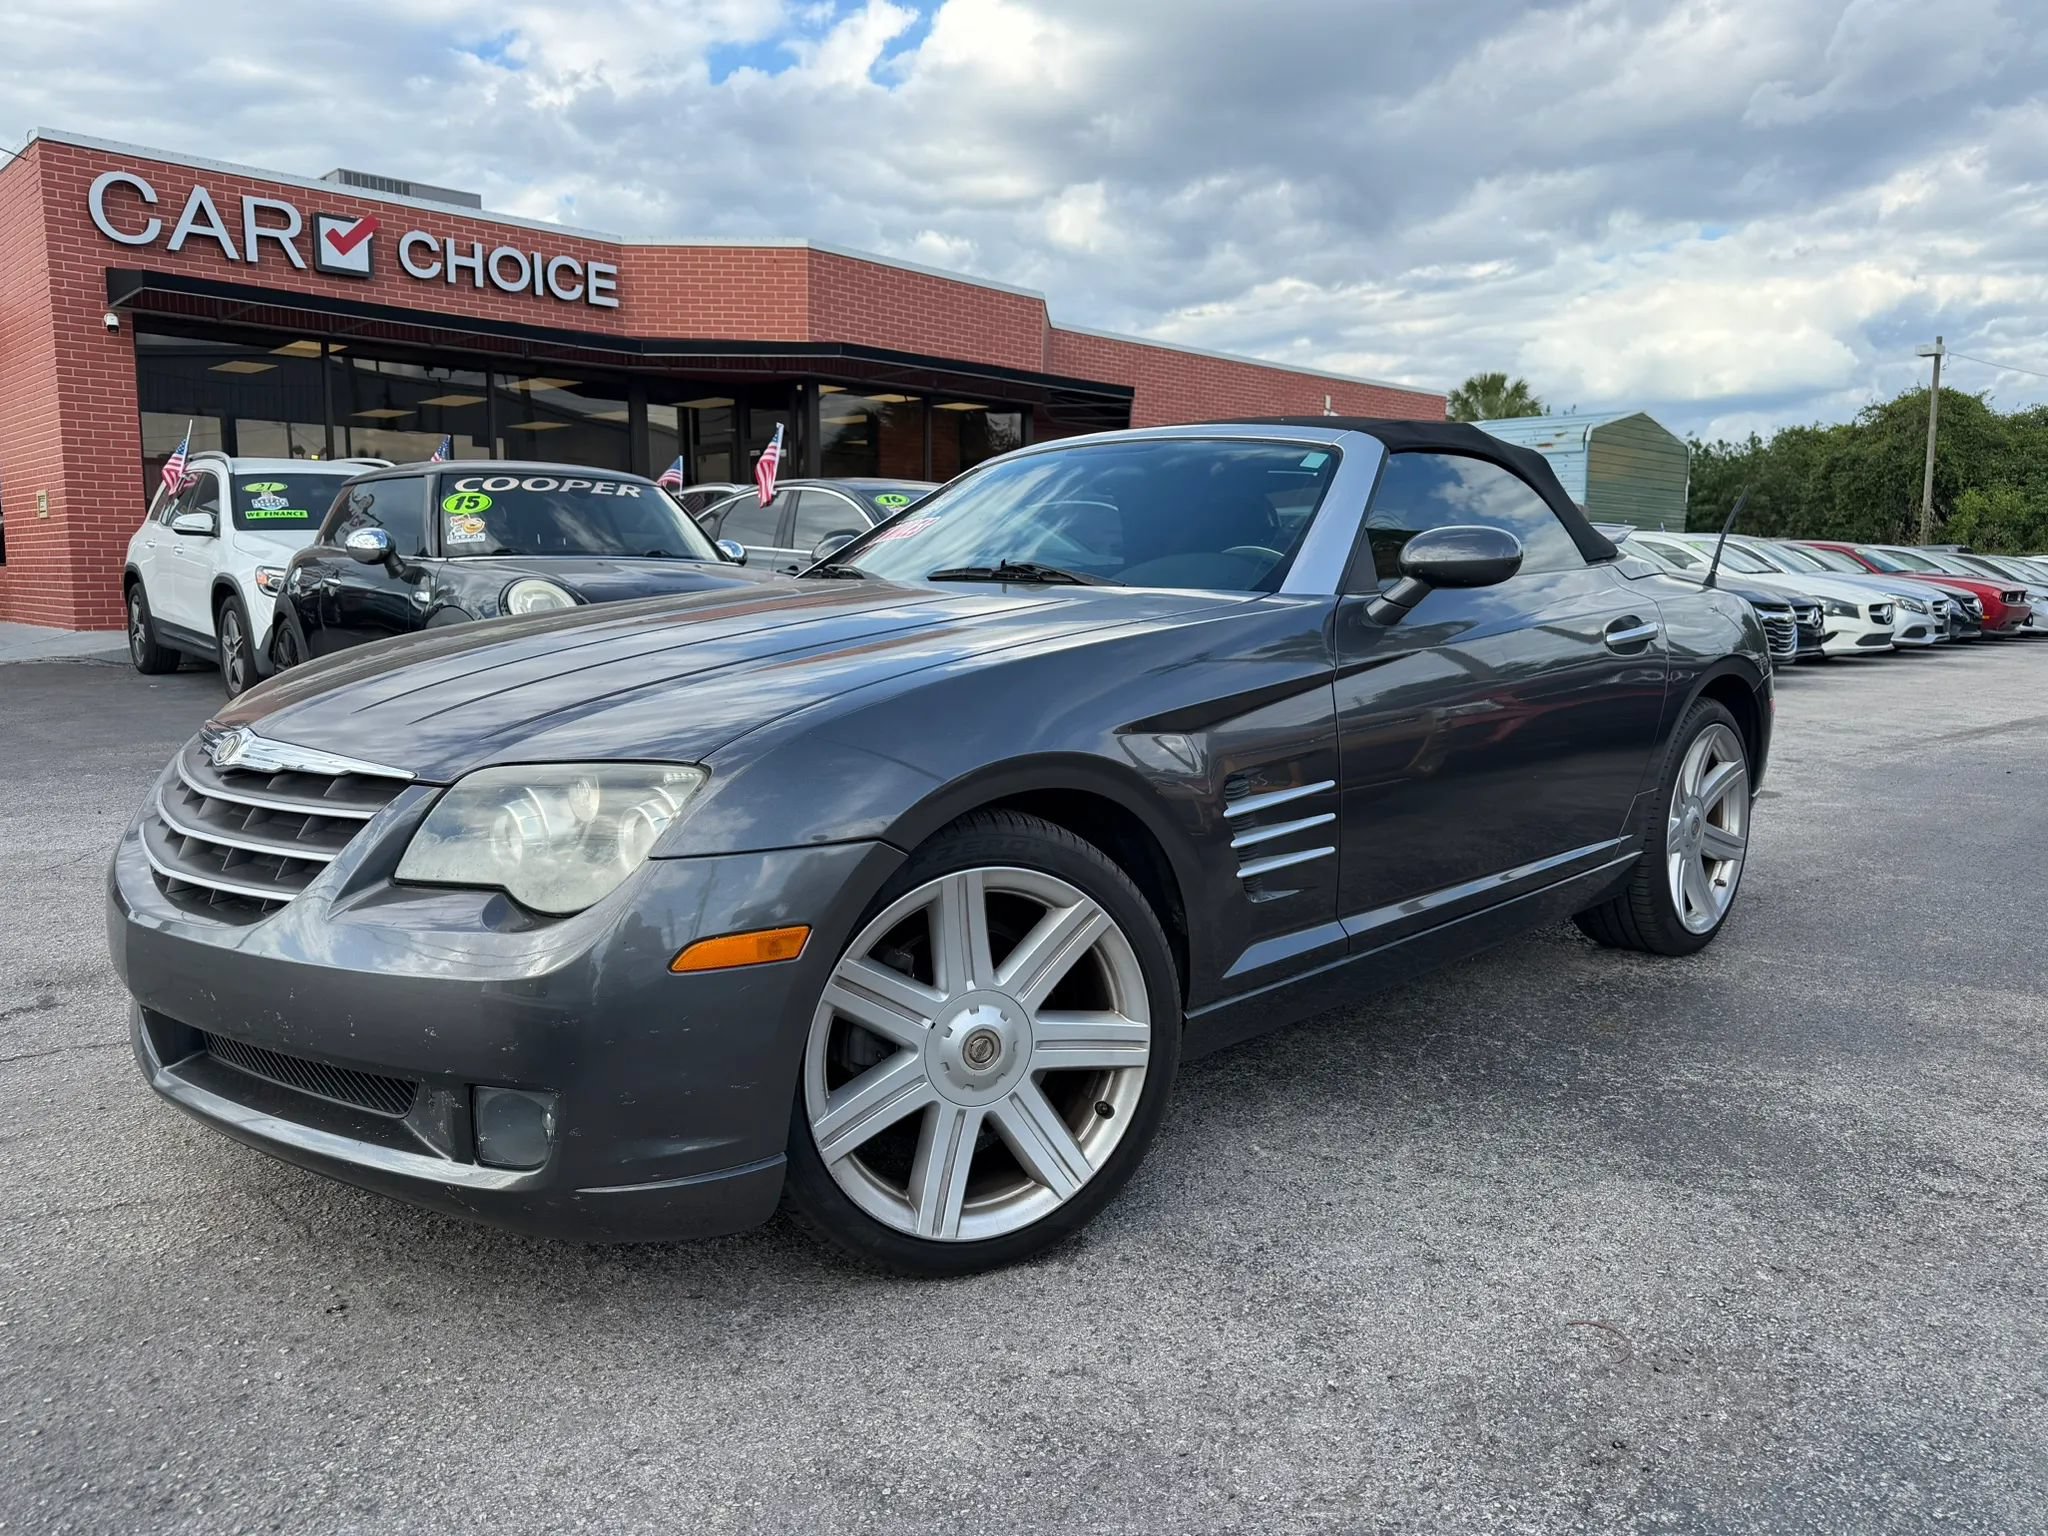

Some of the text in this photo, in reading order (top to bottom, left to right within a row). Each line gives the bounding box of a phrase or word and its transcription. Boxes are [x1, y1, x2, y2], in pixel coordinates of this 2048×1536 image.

[88, 171, 619, 307] CAR CHOICE
[256, 483, 273, 491] 21
[454, 477, 641, 498] COOPER
[454, 495, 481, 511] 15
[884, 495, 902, 503] 16
